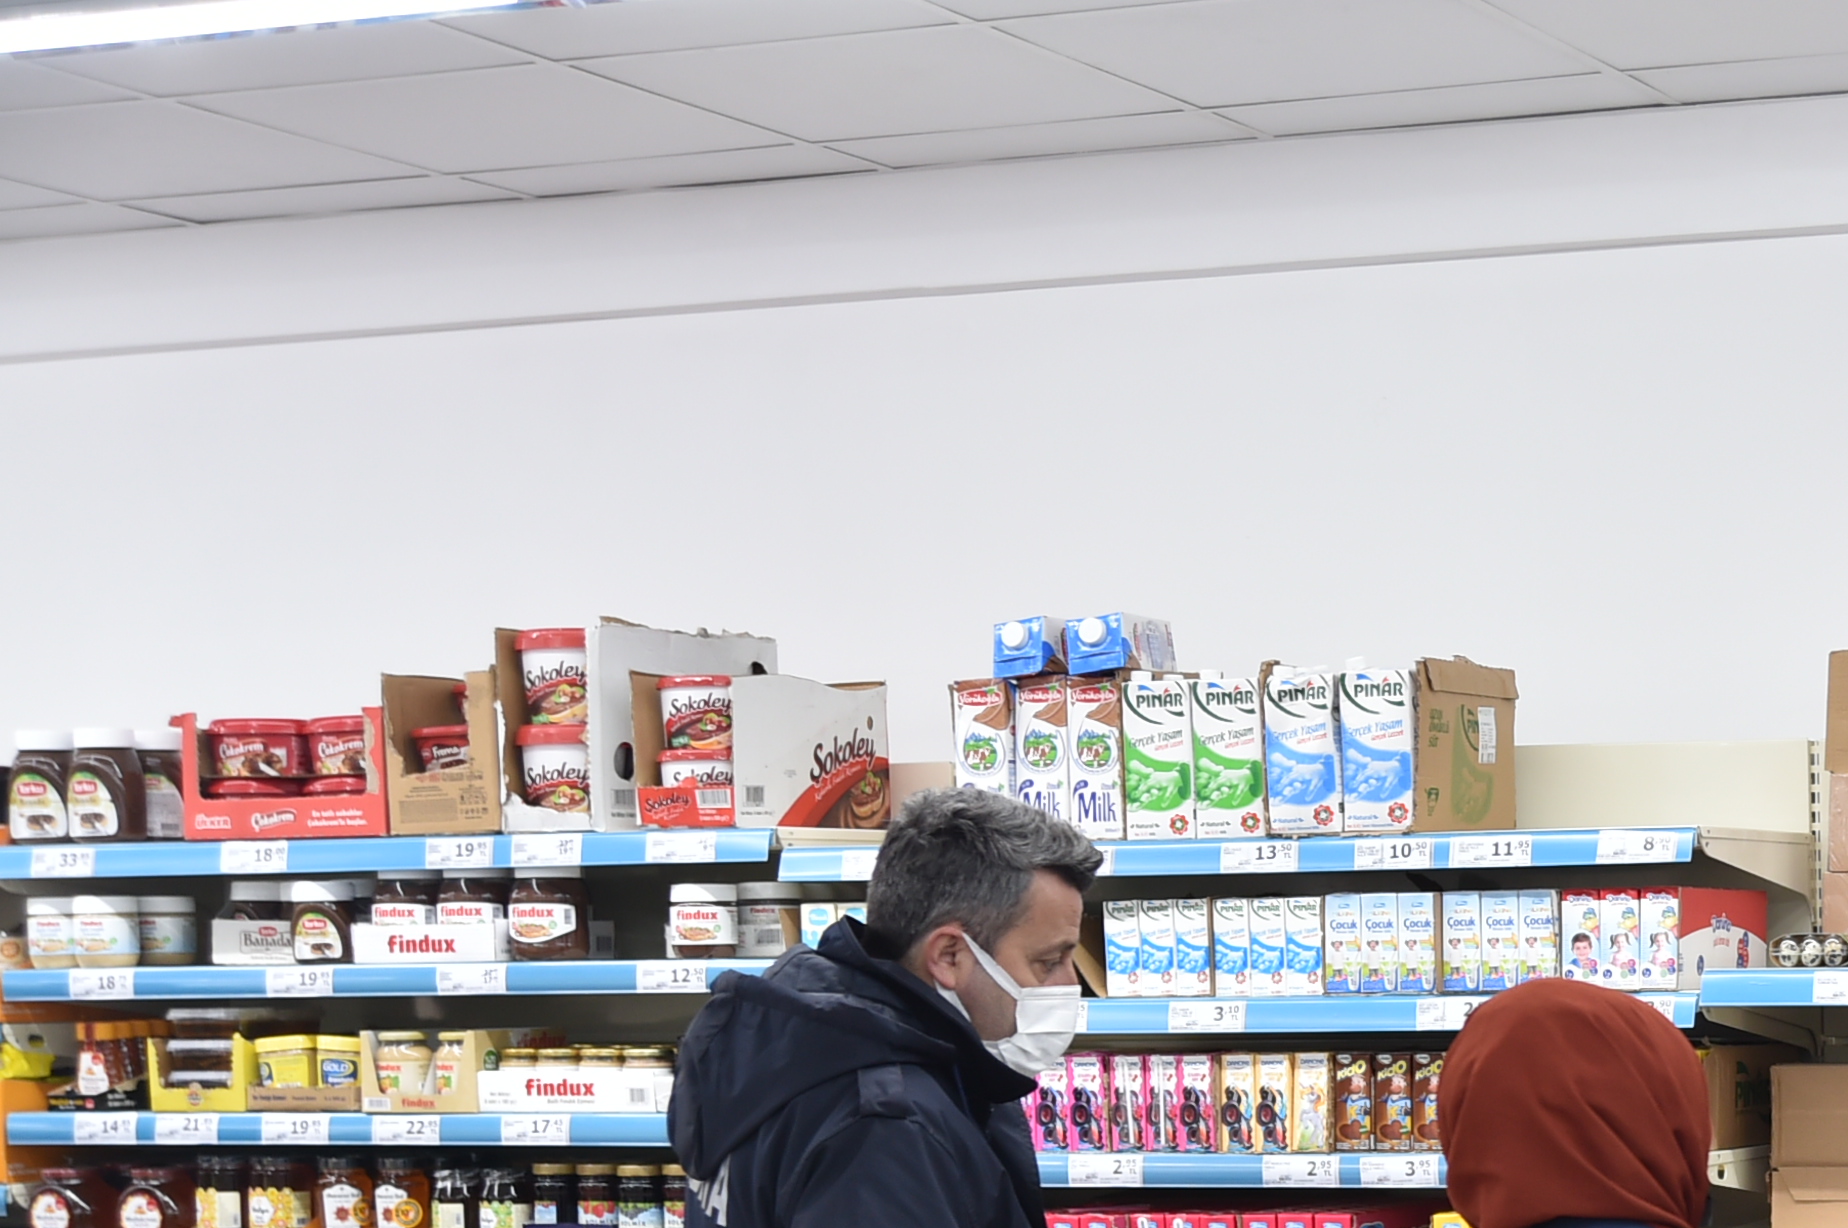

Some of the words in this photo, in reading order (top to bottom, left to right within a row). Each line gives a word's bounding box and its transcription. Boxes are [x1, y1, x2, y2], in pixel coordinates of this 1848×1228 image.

[525, 660, 587, 690] Sokoley
[669, 693, 732, 718] Sokoley
[1301, 723, 1326, 735] Yaşam
[1375, 720, 1403, 733] Yaşam
[1158, 730, 1183, 743] Yaşam
[1228, 727, 1254, 740] Yaşam
[810, 727, 876, 784] Sokoley
[525, 762, 589, 790] Sokoley
[645, 793, 690, 813] Sokoley
[1078, 791, 1117, 823] Milk
[375, 908, 414, 917] findux
[441, 906, 482, 916] findux
[512, 906, 553, 917] findux
[677, 910, 718, 920] findux
[1329, 919, 1358, 932] Çocuk
[1365, 918, 1394, 931] Çocuk
[1403, 917, 1432, 930] Çocuk
[1447, 916, 1476, 929] Çocuk
[1486, 915, 1514, 929] Çocuk
[1524, 914, 1554, 928] Çocuk
[388, 936, 456, 953] findux
[525, 1078, 595, 1097] findux
